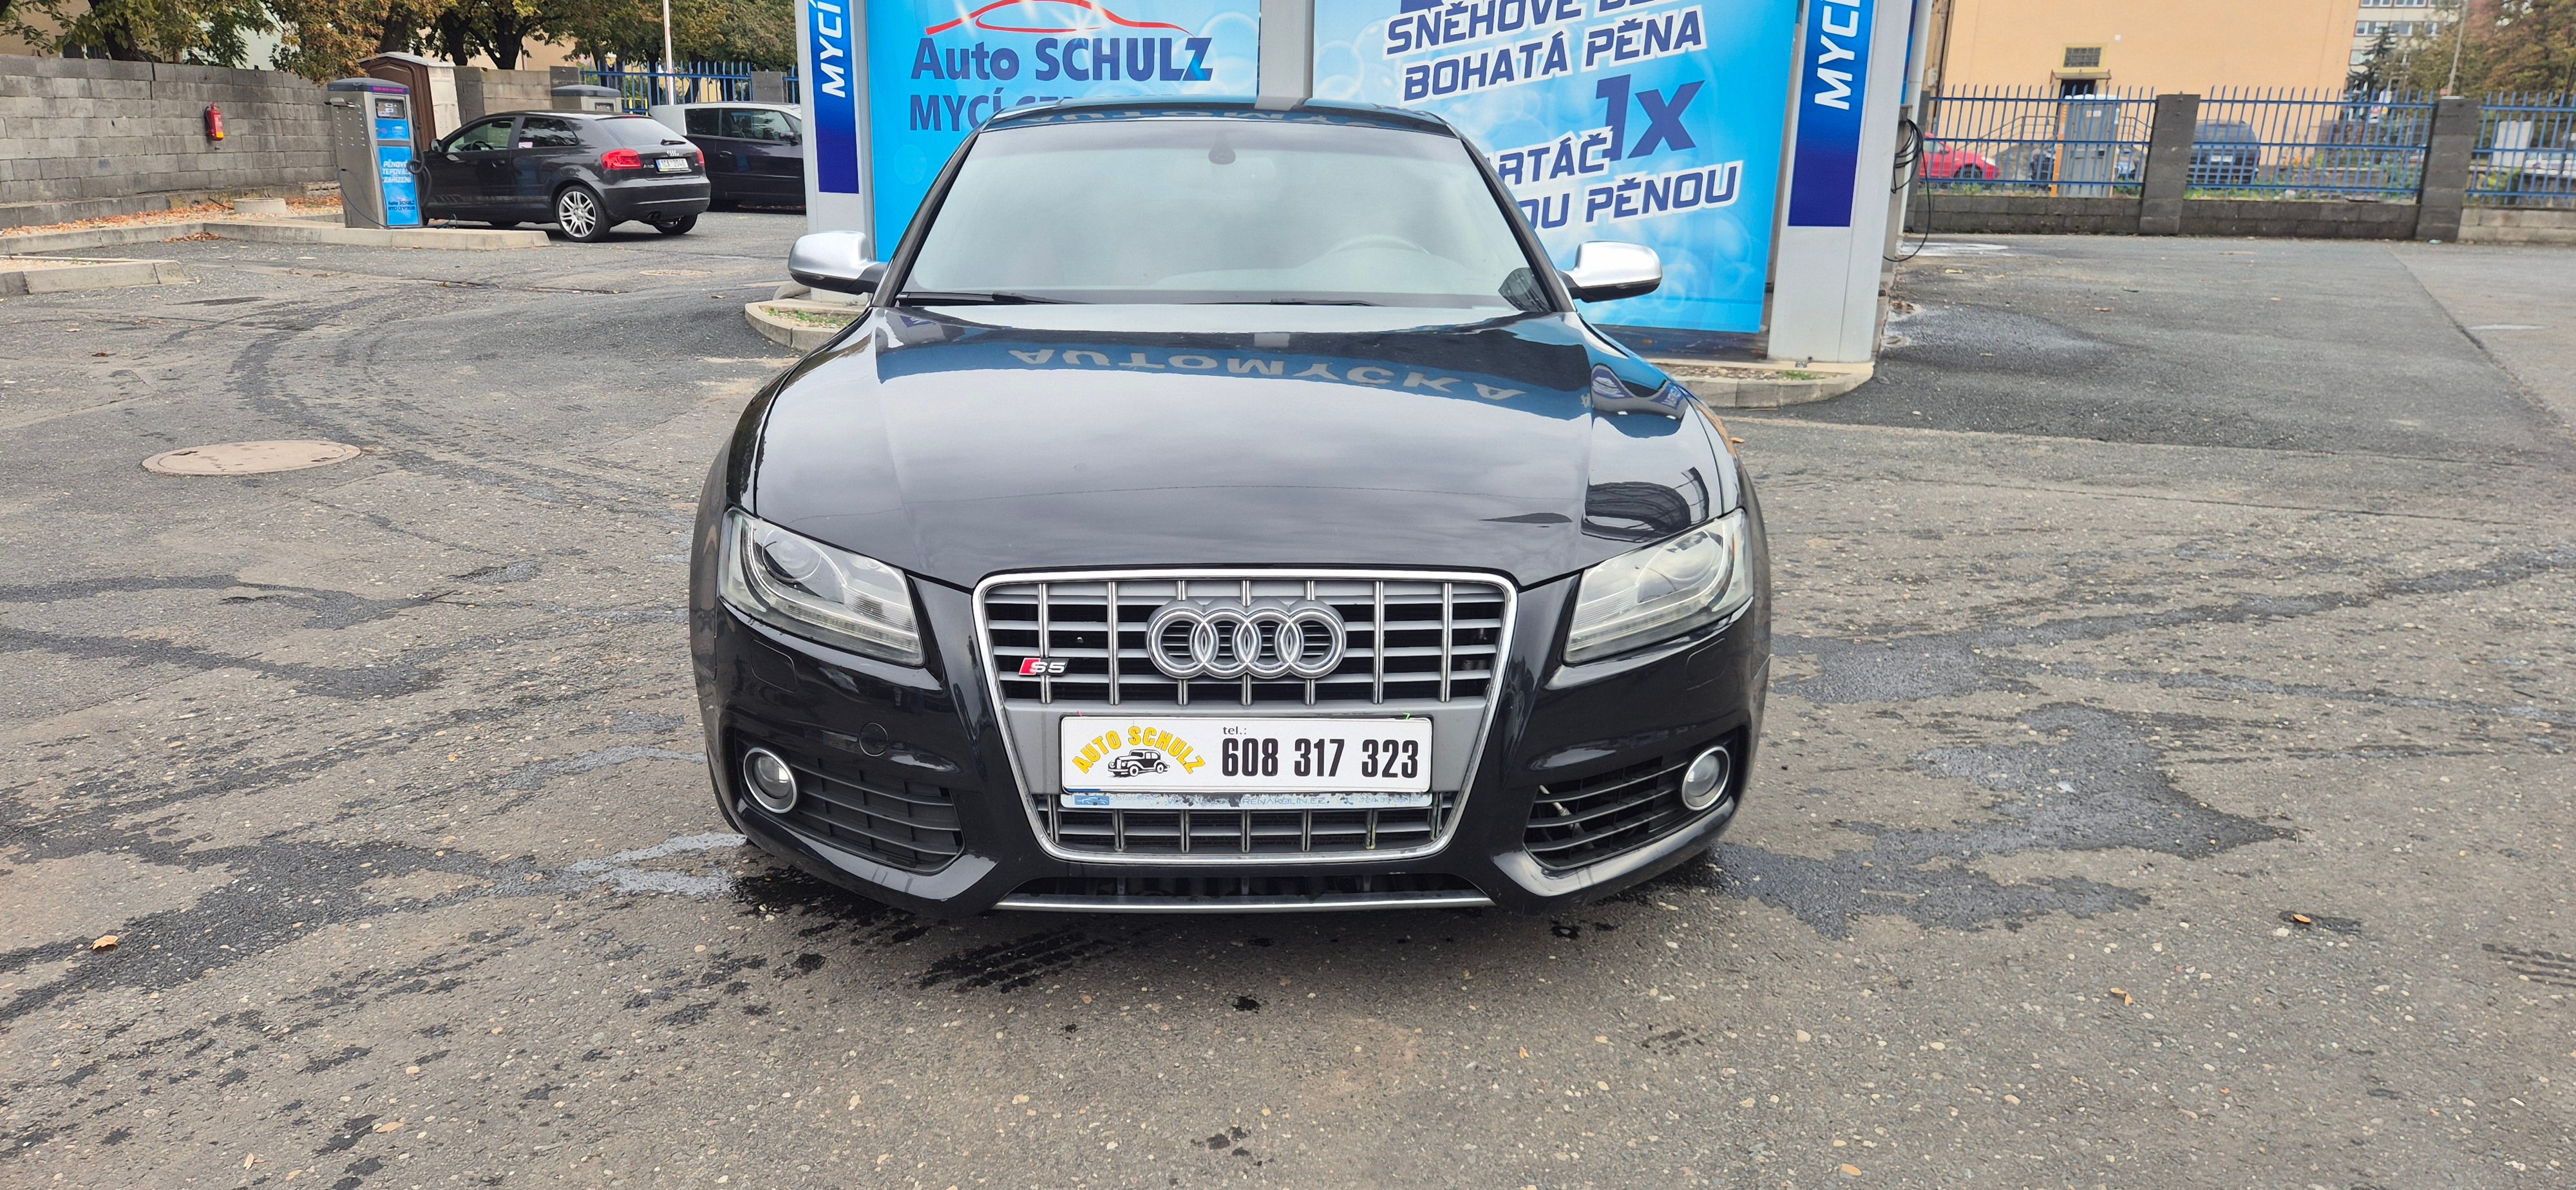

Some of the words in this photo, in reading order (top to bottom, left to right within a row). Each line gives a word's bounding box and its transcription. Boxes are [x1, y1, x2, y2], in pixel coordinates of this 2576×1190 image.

[911, 38, 1019, 80] Auto
[1036, 37, 1212, 81] SCHULZ
[1403, 31, 1568, 102] BOHATÁ
[1586, 10, 1703, 67] PĚNA
[1595, 73, 1705, 162] 1x
[1586, 165, 1738, 222] PĚNOU
[1030, 661, 1066, 674] S5
[1072, 731, 1122, 774] AUTO
[1128, 726, 1206, 775] SCHULZ
[1222, 726, 1247, 735] tel.:
[1222, 738, 1278, 777] 608
[1294, 738, 1345, 777] 317
[1361, 739, 1419, 779] 323
